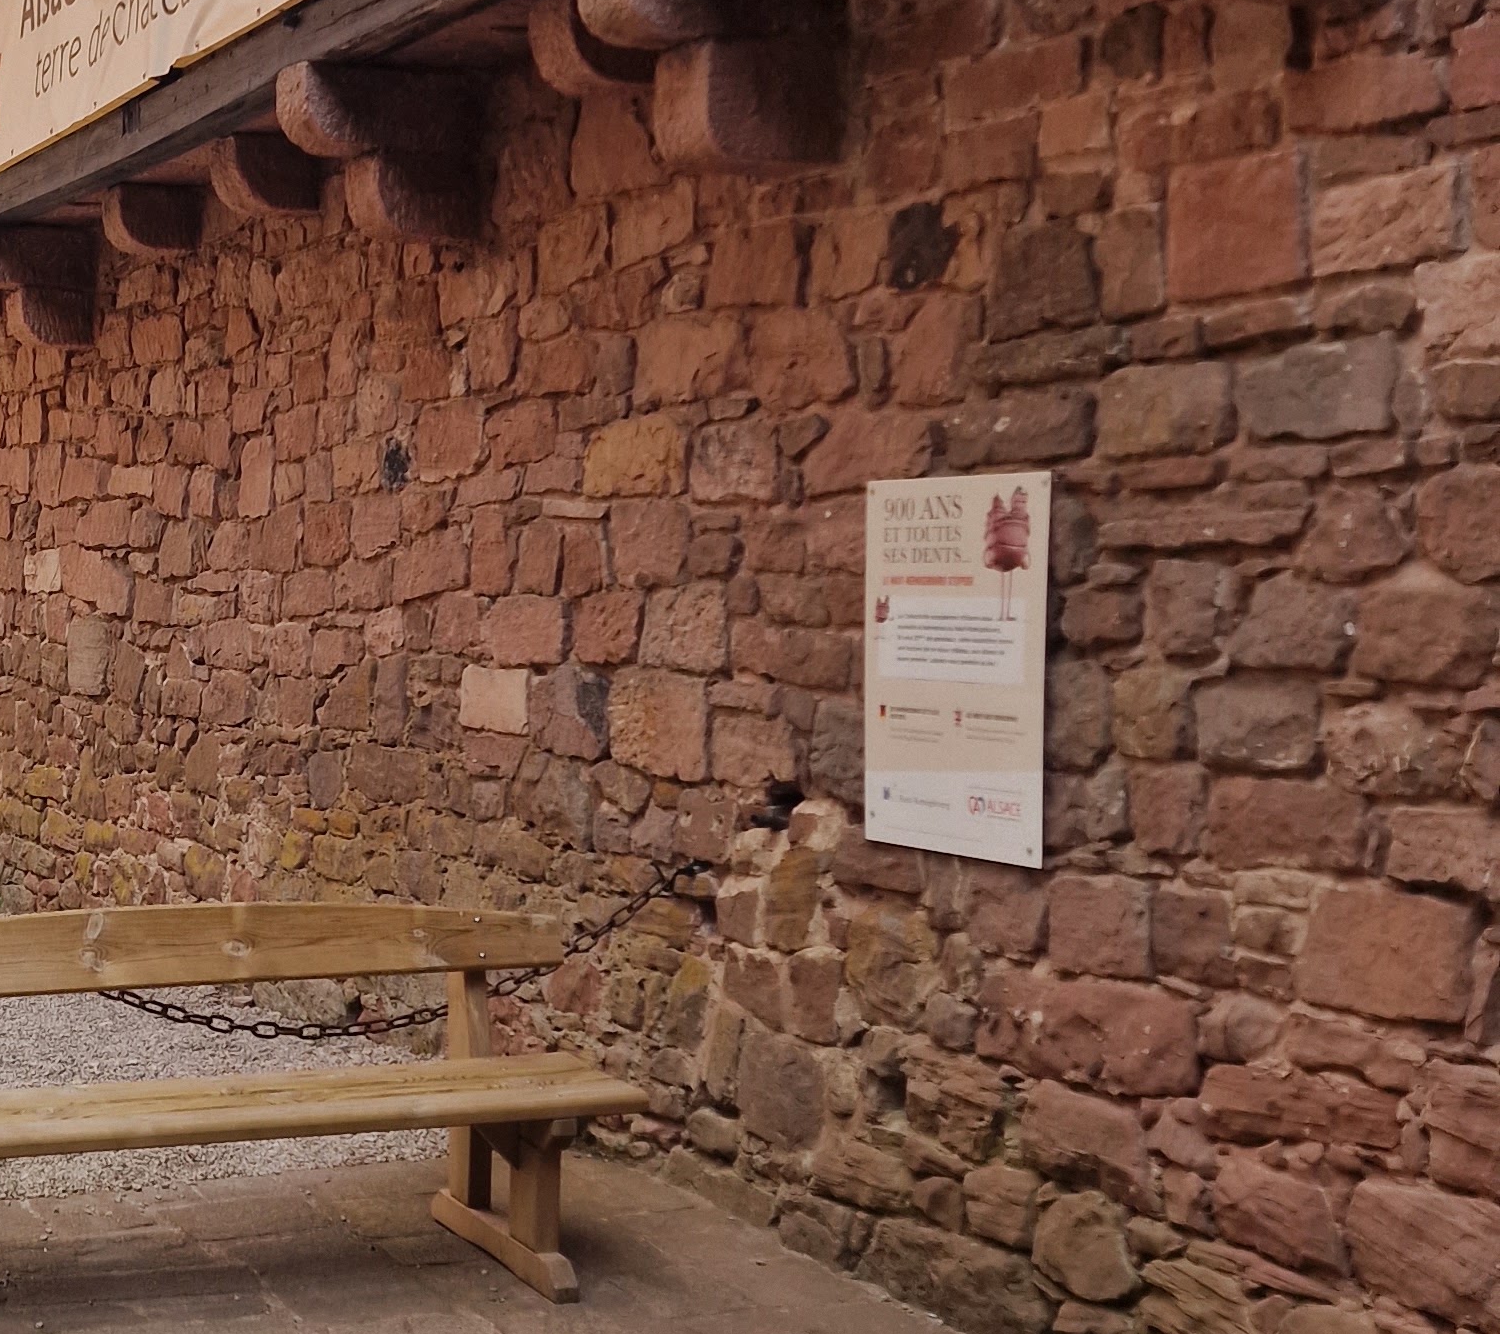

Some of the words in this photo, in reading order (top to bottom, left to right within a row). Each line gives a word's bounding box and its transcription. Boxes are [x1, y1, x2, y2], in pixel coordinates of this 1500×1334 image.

[34, 35, 82, 98] terre
[87, 8, 111, 67] de
[883, 497, 916, 521] 900
[918, 494, 964, 520] ANS
[883, 527, 901, 543] ET
[905, 525, 962, 543] TOUTES
[883, 547, 908, 564] SES
